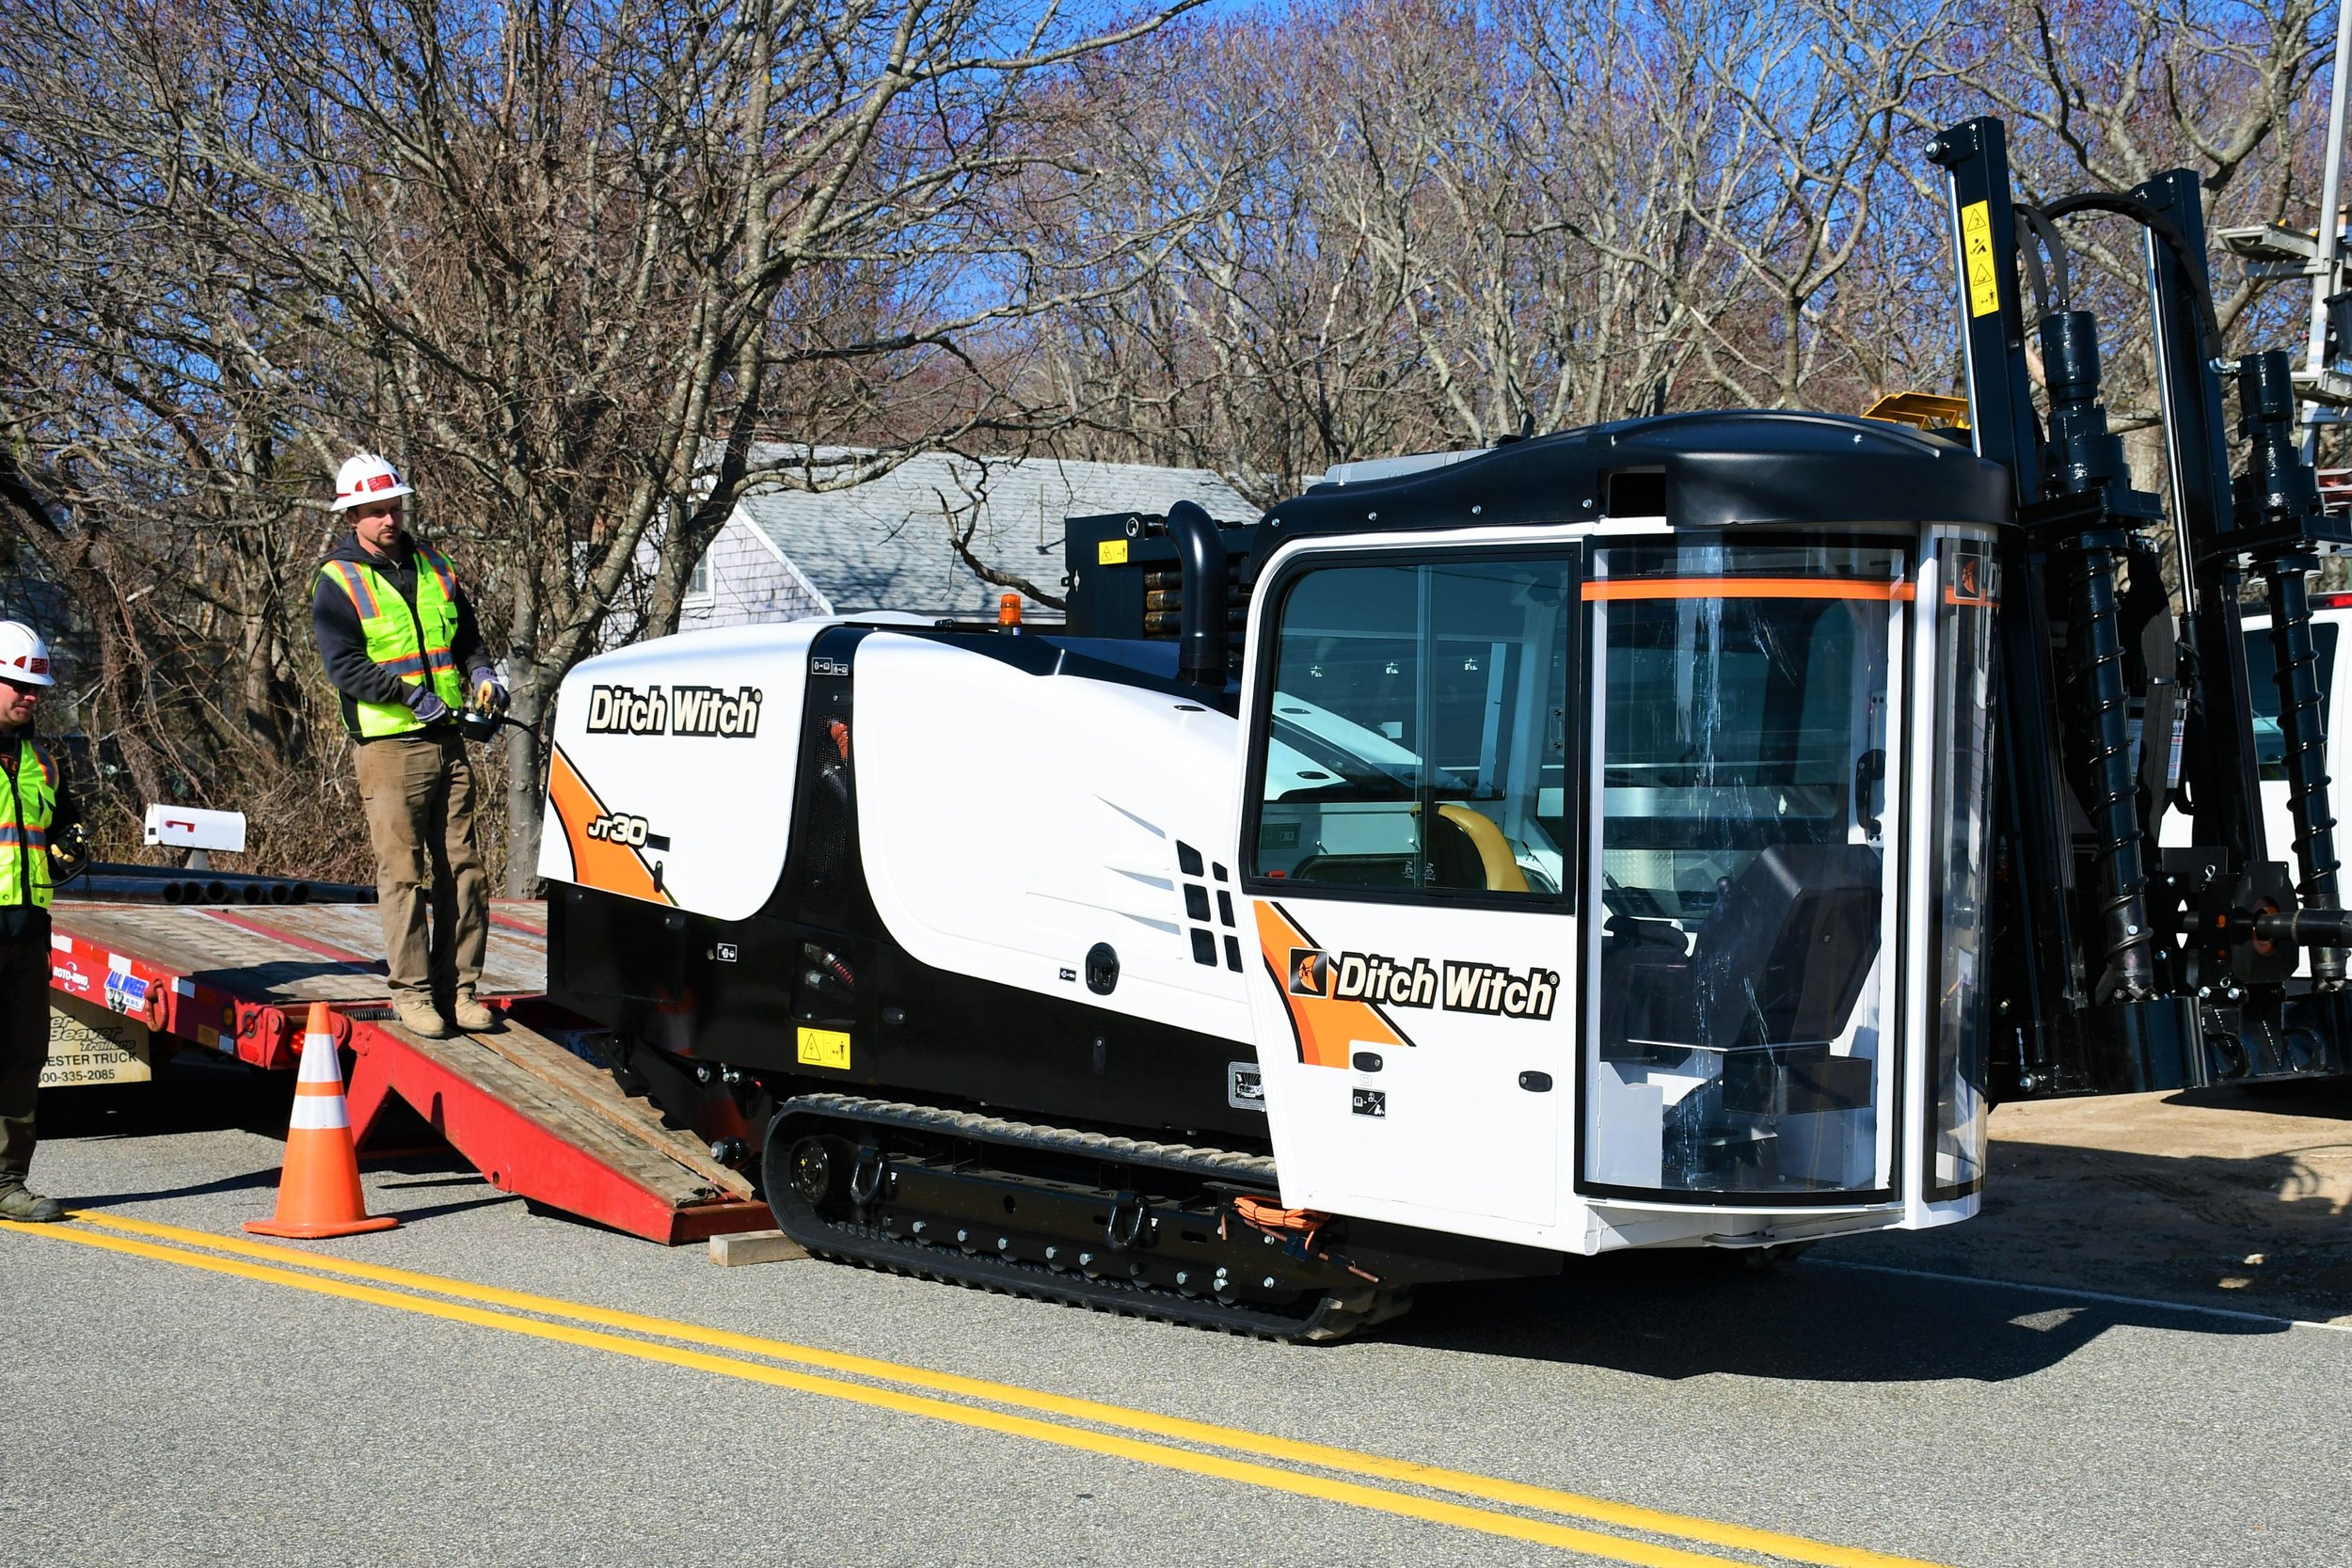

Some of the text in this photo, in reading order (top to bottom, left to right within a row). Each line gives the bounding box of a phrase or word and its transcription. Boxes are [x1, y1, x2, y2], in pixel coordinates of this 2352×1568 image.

[587, 685, 668, 736] Ditch
[587, 813, 649, 848] JT30
[1334, 951, 1438, 1009] Ditch
[93, 1052, 137, 1064] TRUCK
